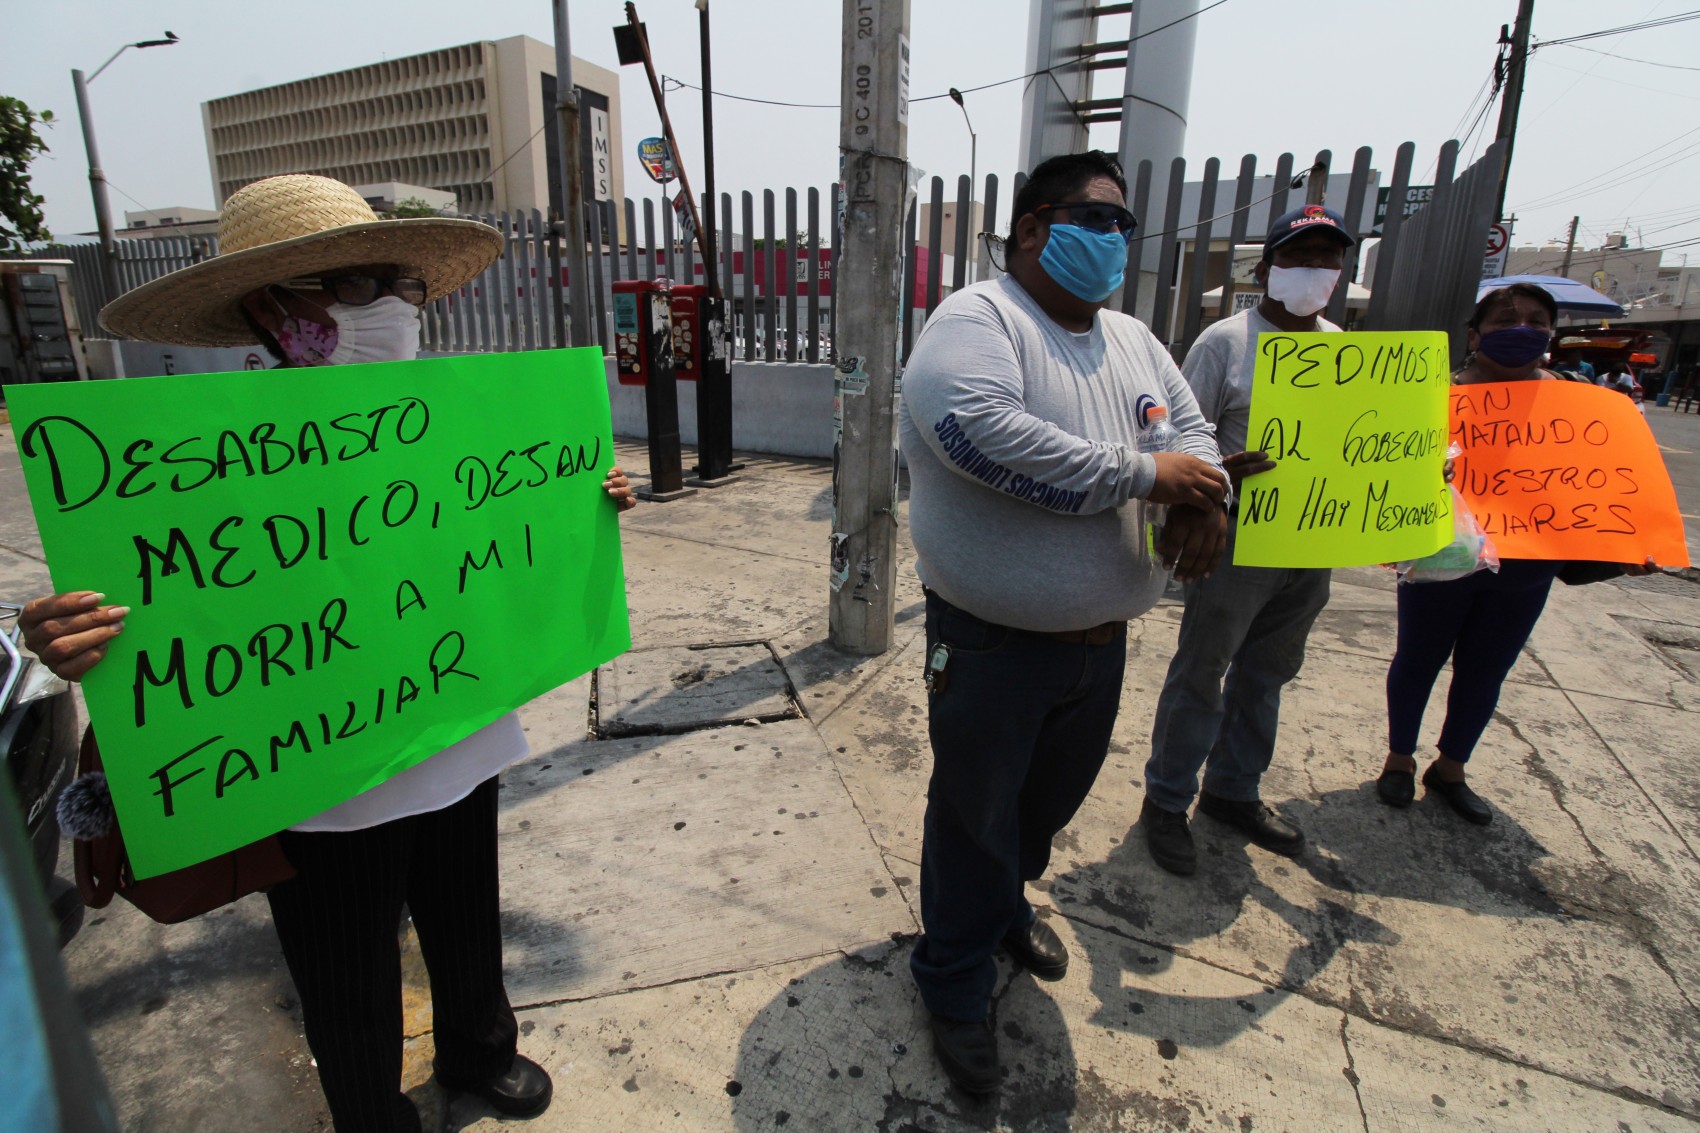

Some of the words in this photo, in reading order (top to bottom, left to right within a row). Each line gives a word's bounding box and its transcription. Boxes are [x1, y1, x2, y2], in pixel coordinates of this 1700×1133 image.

[856, 64, 871, 100] 400
[595, 116, 607, 195] IMSS
[1290, 216, 1337, 226] REKLAMA
[1263, 337, 1430, 387] PEDIMOS
[22, 397, 430, 512] DESABASTO
[934, 412, 1013, 489] LUMINOSOS
[1259, 417, 1310, 461] AL
[1004, 473, 1090, 514] ANUNCIOS
[1243, 487, 1279, 526] NO
[1297, 477, 1350, 531] HAY
[1475, 504, 1636, 536] LIARES
[132, 480, 440, 606] MEDICO,
[455, 436, 600, 510] DEJAN
[132, 597, 360, 728] MORIR
[396, 580, 427, 620] A
[458, 524, 534, 594] MI
[150, 630, 480, 817] FAMILIAR
